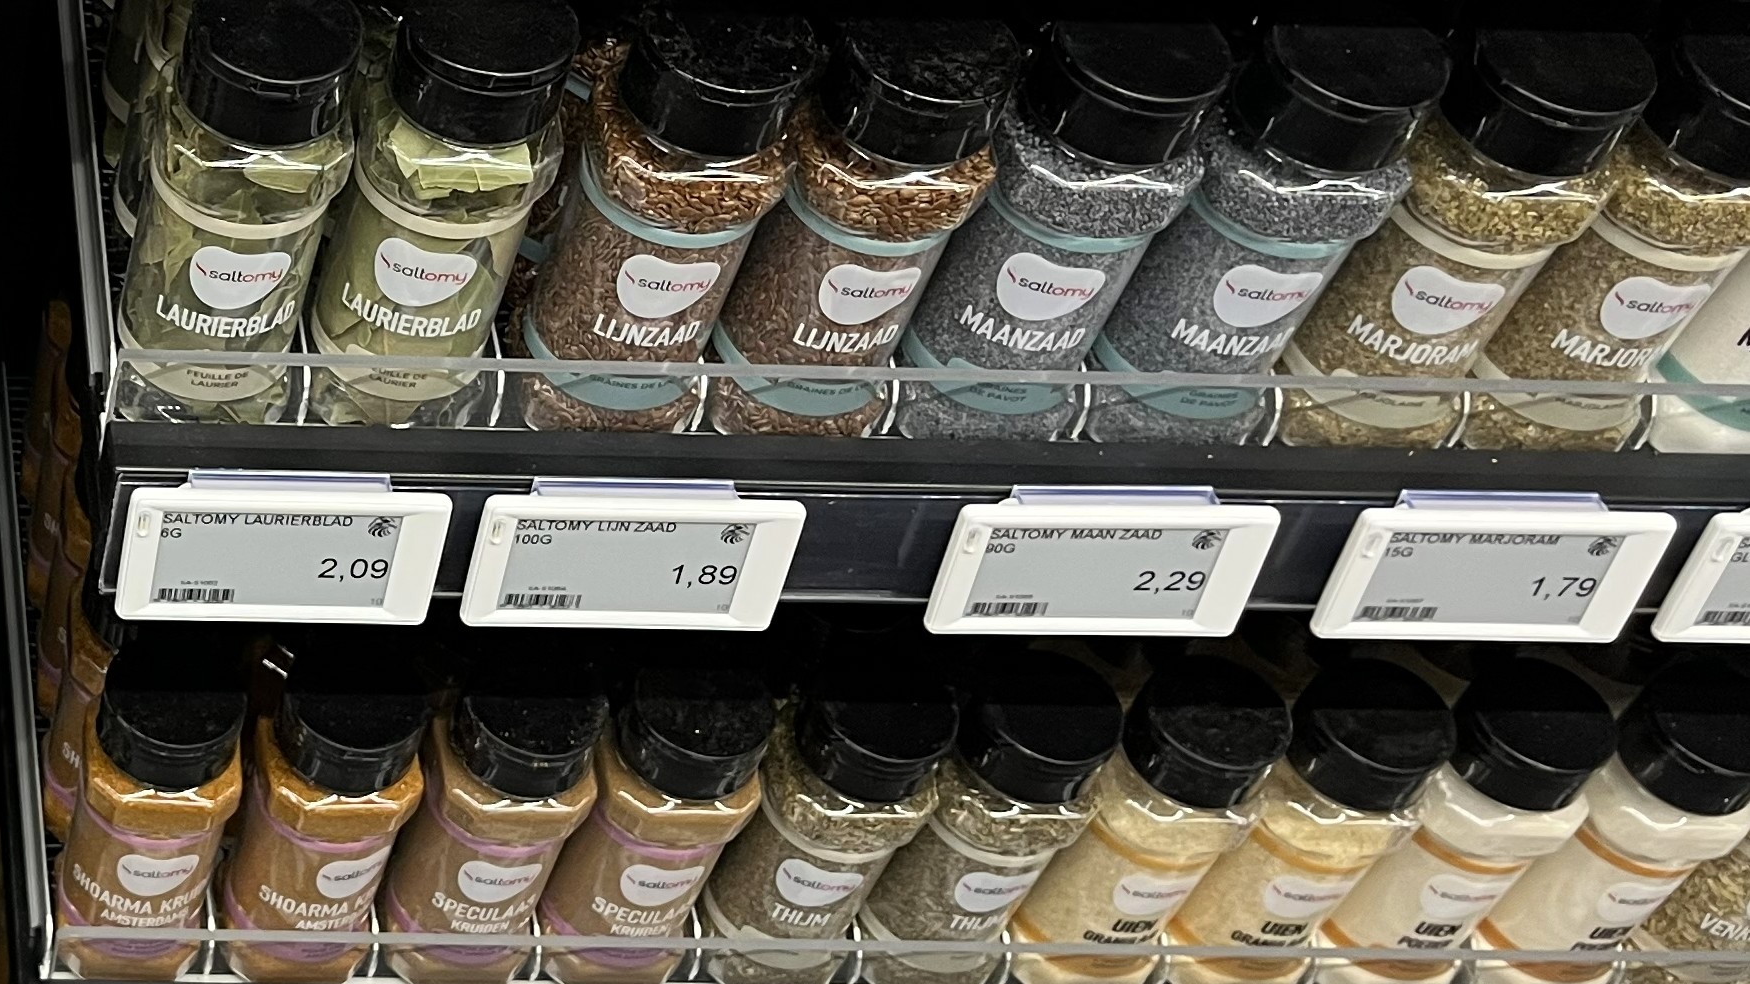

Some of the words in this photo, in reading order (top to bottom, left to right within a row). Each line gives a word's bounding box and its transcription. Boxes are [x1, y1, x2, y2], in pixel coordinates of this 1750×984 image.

[209, 268, 283, 284] saltomy
[392, 261, 468, 285] saltomy
[638, 278, 711, 294] saltomy
[840, 283, 912, 299] saltomy
[1018, 276, 1094, 299] saltomy
[342, 282, 481, 338] LAURIERBLAD
[1415, 289, 1492, 314] saltomy
[156, 295, 295, 338] LAURIERBLAD
[959, 304, 1086, 352] MAANZAAD
[593, 314, 701, 347] LIJNZAAD
[792, 323, 899, 354] LIJNZAAD
[191, 380, 238, 388] LAURIER
[163, 514, 241, 525] SALTOMY
[244, 515, 353, 527] LAURIERBLAD
[516, 521, 594, 532] SALTOMY
[598, 521, 632, 533] LIJN
[633, 522, 677, 533] ZAAD
[160, 528, 182, 538] 6G
[514, 534, 552, 545] 100G
[990, 529, 1066, 541] SALTOMY
[1070, 530, 1115, 541] MAAN
[1119, 530, 1162, 541] ZAAD
[1384, 546, 1414, 557] 15G
[317, 558, 389, 581] 2,09
[672, 564, 738, 588] 1,89
[1133, 570, 1207, 594] 2,29
[1532, 576, 1597, 600] 1,79
[72, 864, 152, 914] SHOARMA
[259, 885, 348, 918] SHOARMA
[770, 902, 831, 927] THIJM
